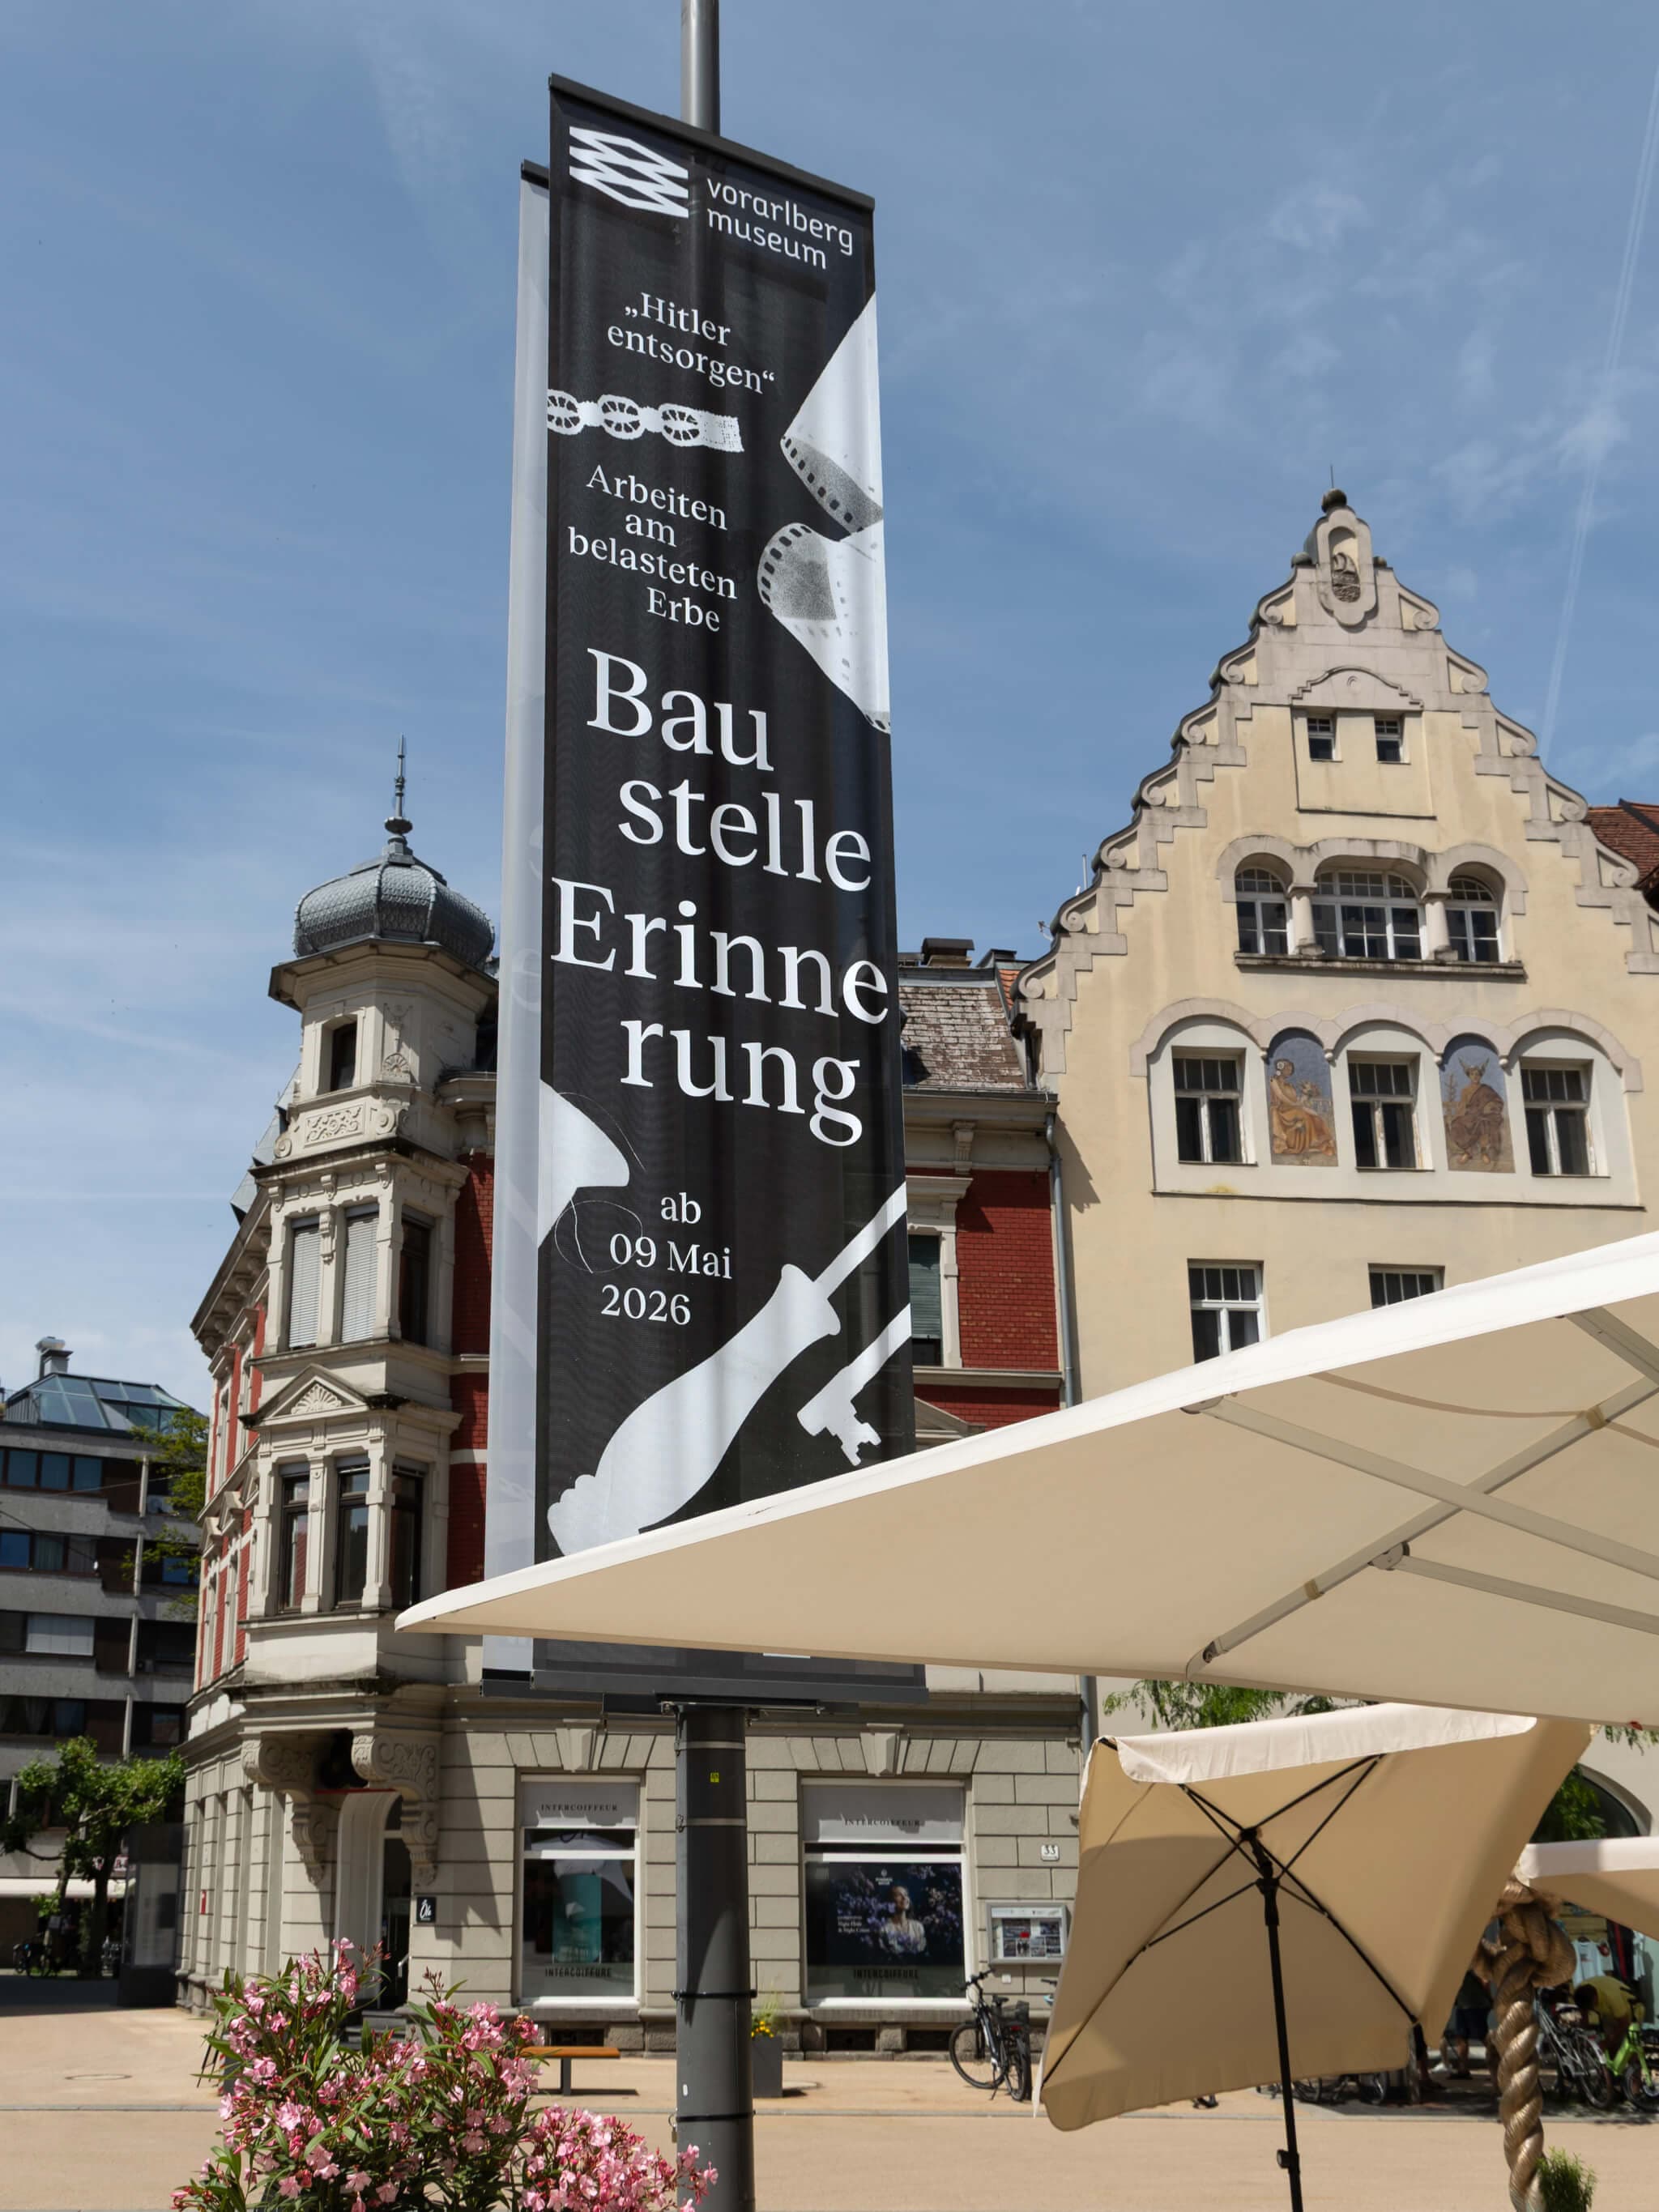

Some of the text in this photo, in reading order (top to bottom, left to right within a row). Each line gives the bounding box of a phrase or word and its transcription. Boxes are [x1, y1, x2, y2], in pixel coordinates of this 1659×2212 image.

[707, 178, 853, 256] vorarlberg
[707, 208, 826, 270] museum
[625, 292, 732, 354] „Hitler
[608, 326, 775, 394] entsorgen“
[586, 464, 727, 531] Arbeiten
[625, 514, 676, 548] am
[568, 526, 737, 599] belasteten
[646, 586, 720, 632] Erbe
[586, 647, 774, 772] Bau
[618, 779, 872, 893] stelle
[550, 876, 889, 1025] Erinne
[620, 1020, 864, 1148] rung
[660, 1191, 702, 1225] ab
[609, 1233, 732, 1279] 09 Mai
[600, 1284, 691, 1325] 2026
